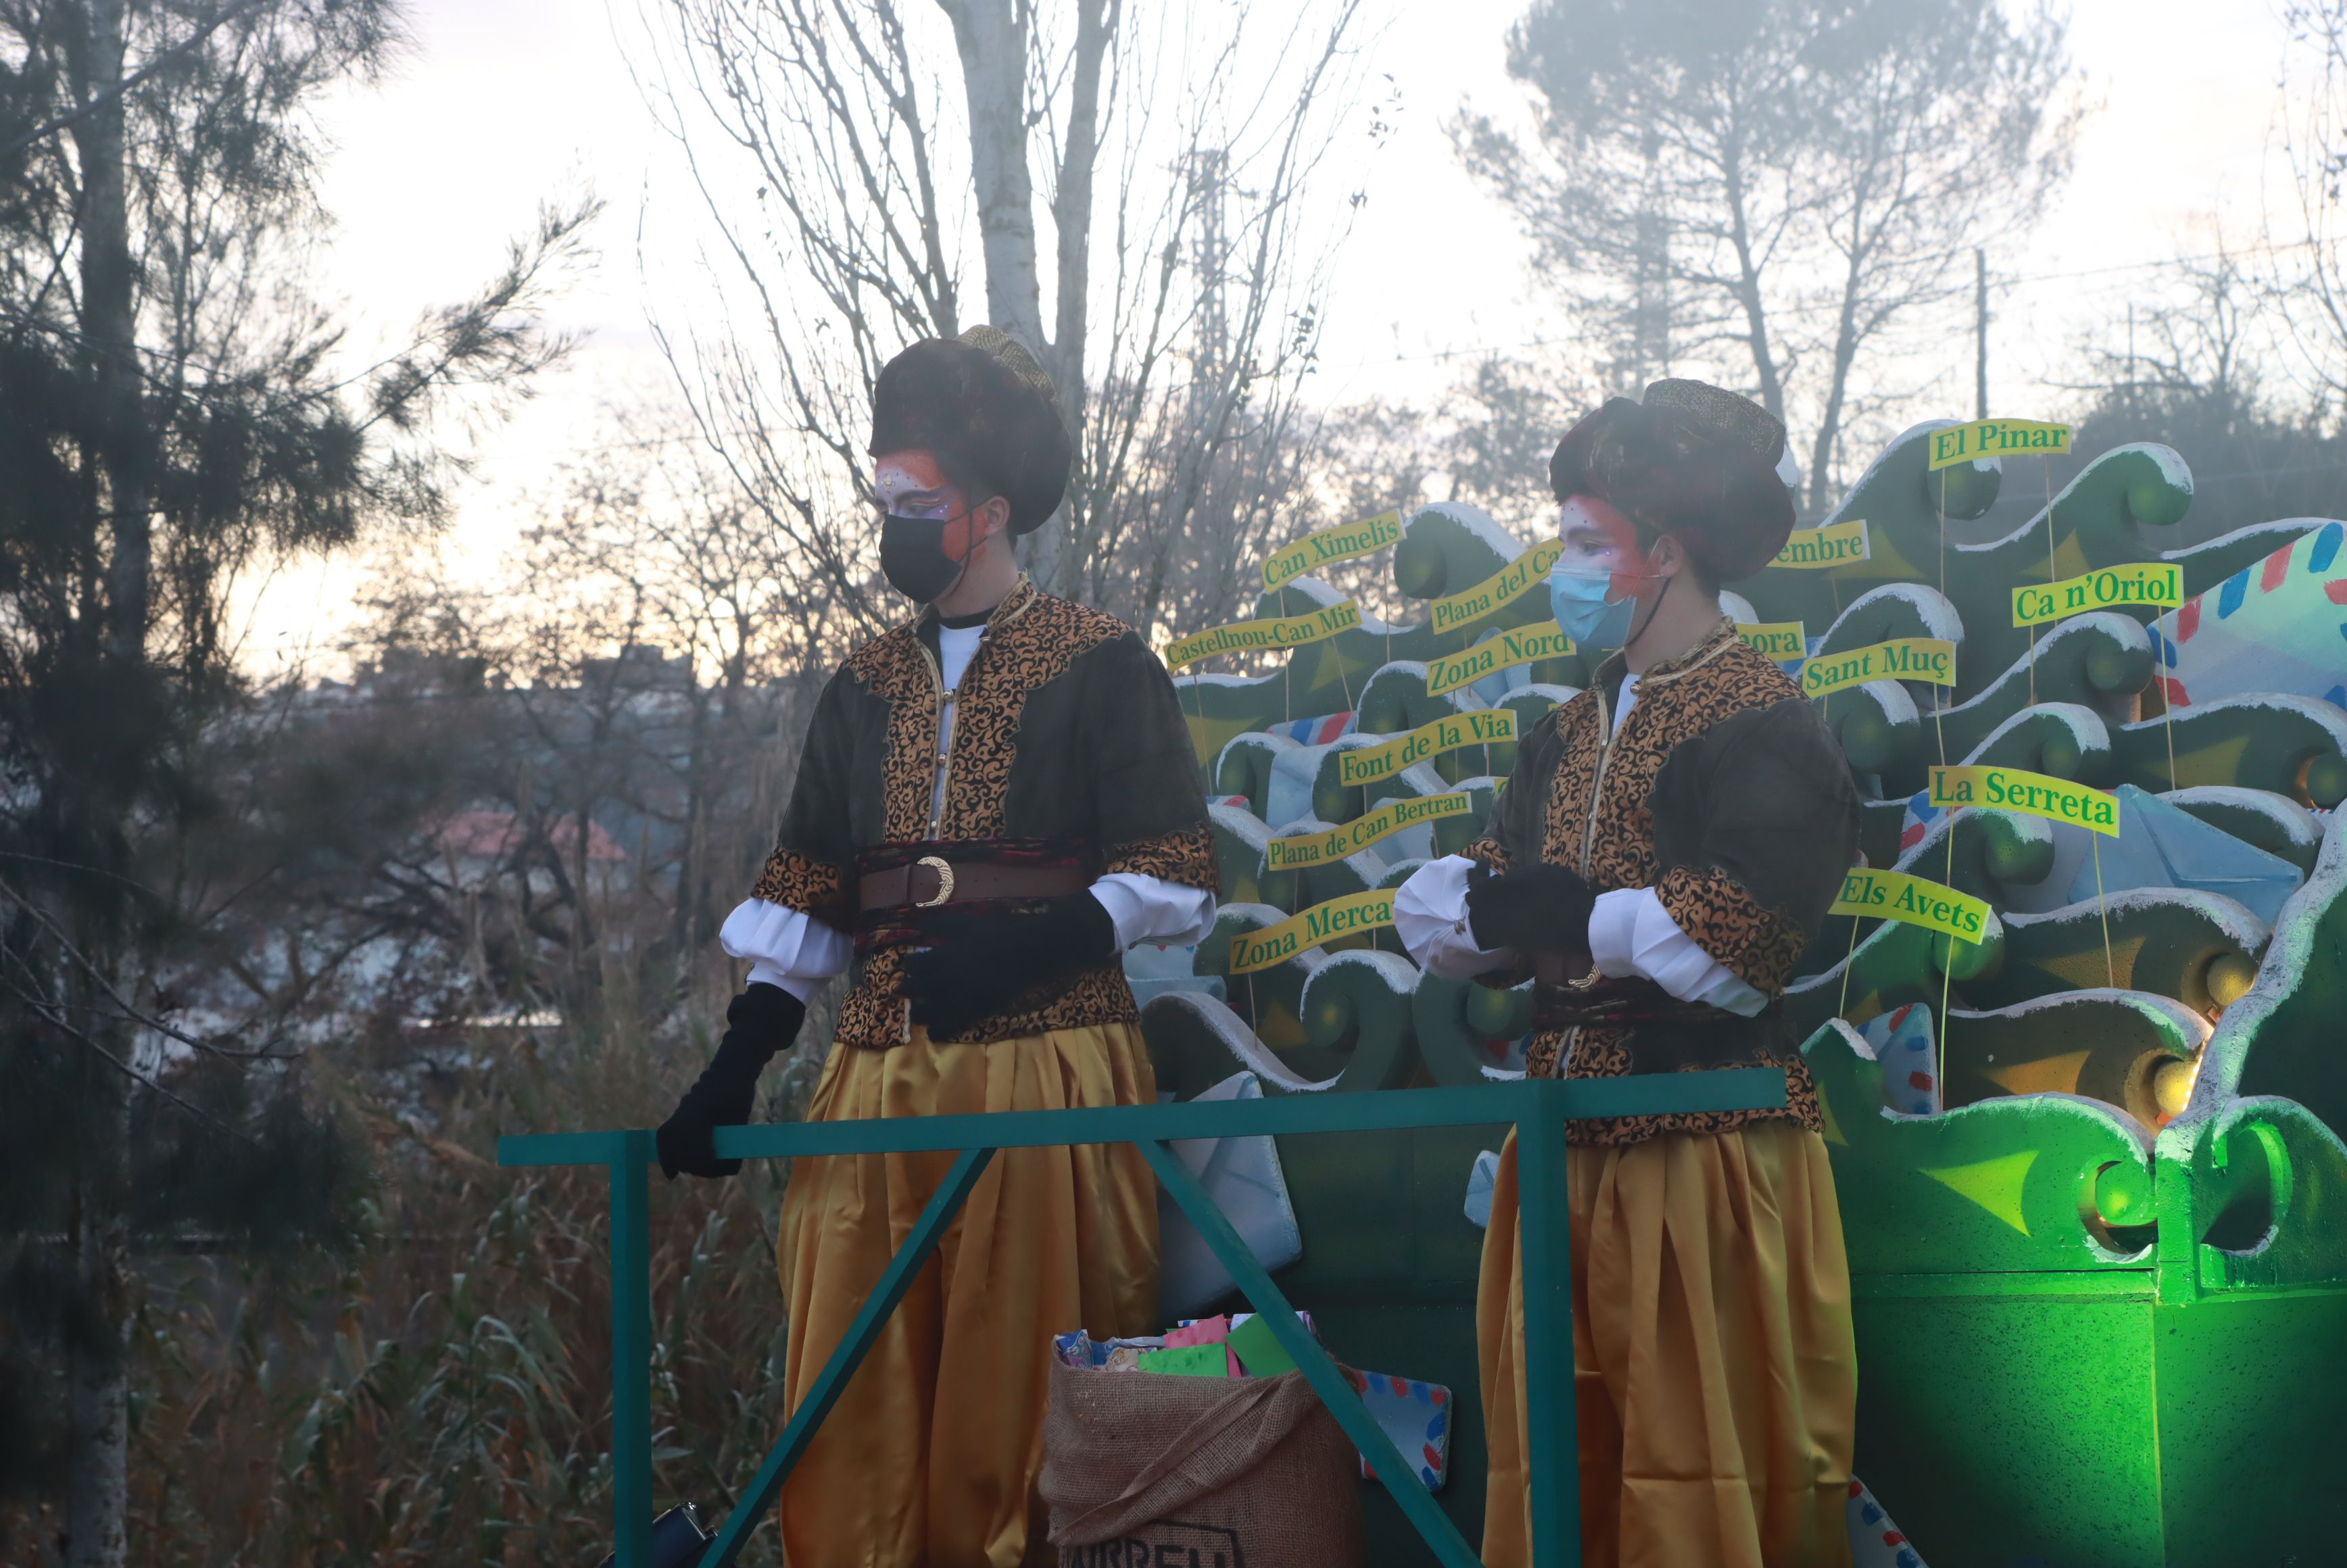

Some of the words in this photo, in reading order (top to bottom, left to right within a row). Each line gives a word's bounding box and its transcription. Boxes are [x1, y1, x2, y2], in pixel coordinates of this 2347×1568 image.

[1935, 429, 1966, 462] El
[1978, 424, 2068, 452] Pinar
[1265, 552, 1307, 585] Can
[1309, 518, 1399, 561] Ximelis
[1435, 593, 1491, 628] Plana
[1496, 561, 1528, 601] del
[2016, 589, 2056, 620] Ca
[1166, 622, 1314, 665] Castellnou-Can
[1317, 606, 1356, 633] Mir
[1430, 647, 1493, 691] Zona
[1502, 633, 1570, 663] Nord
[1806, 653, 1872, 691] Sant
[1882, 645, 1948, 679] Muç
[1343, 750, 1394, 783] Font
[1403, 733, 1431, 762] de
[1438, 722, 1462, 748] la
[1469, 712, 1512, 743] Via
[1934, 770, 1975, 802] La
[1985, 773, 2114, 826] Serreta
[1269, 841, 1320, 866] Plana
[1325, 833, 1348, 858] de
[1352, 816, 1390, 846] Can
[1394, 794, 1468, 825] Bertran
[1840, 875, 1886, 906] Els
[1893, 883, 1979, 933] Avets
[1233, 931, 1298, 970] Zona
[1305, 899, 1395, 943] Merca
